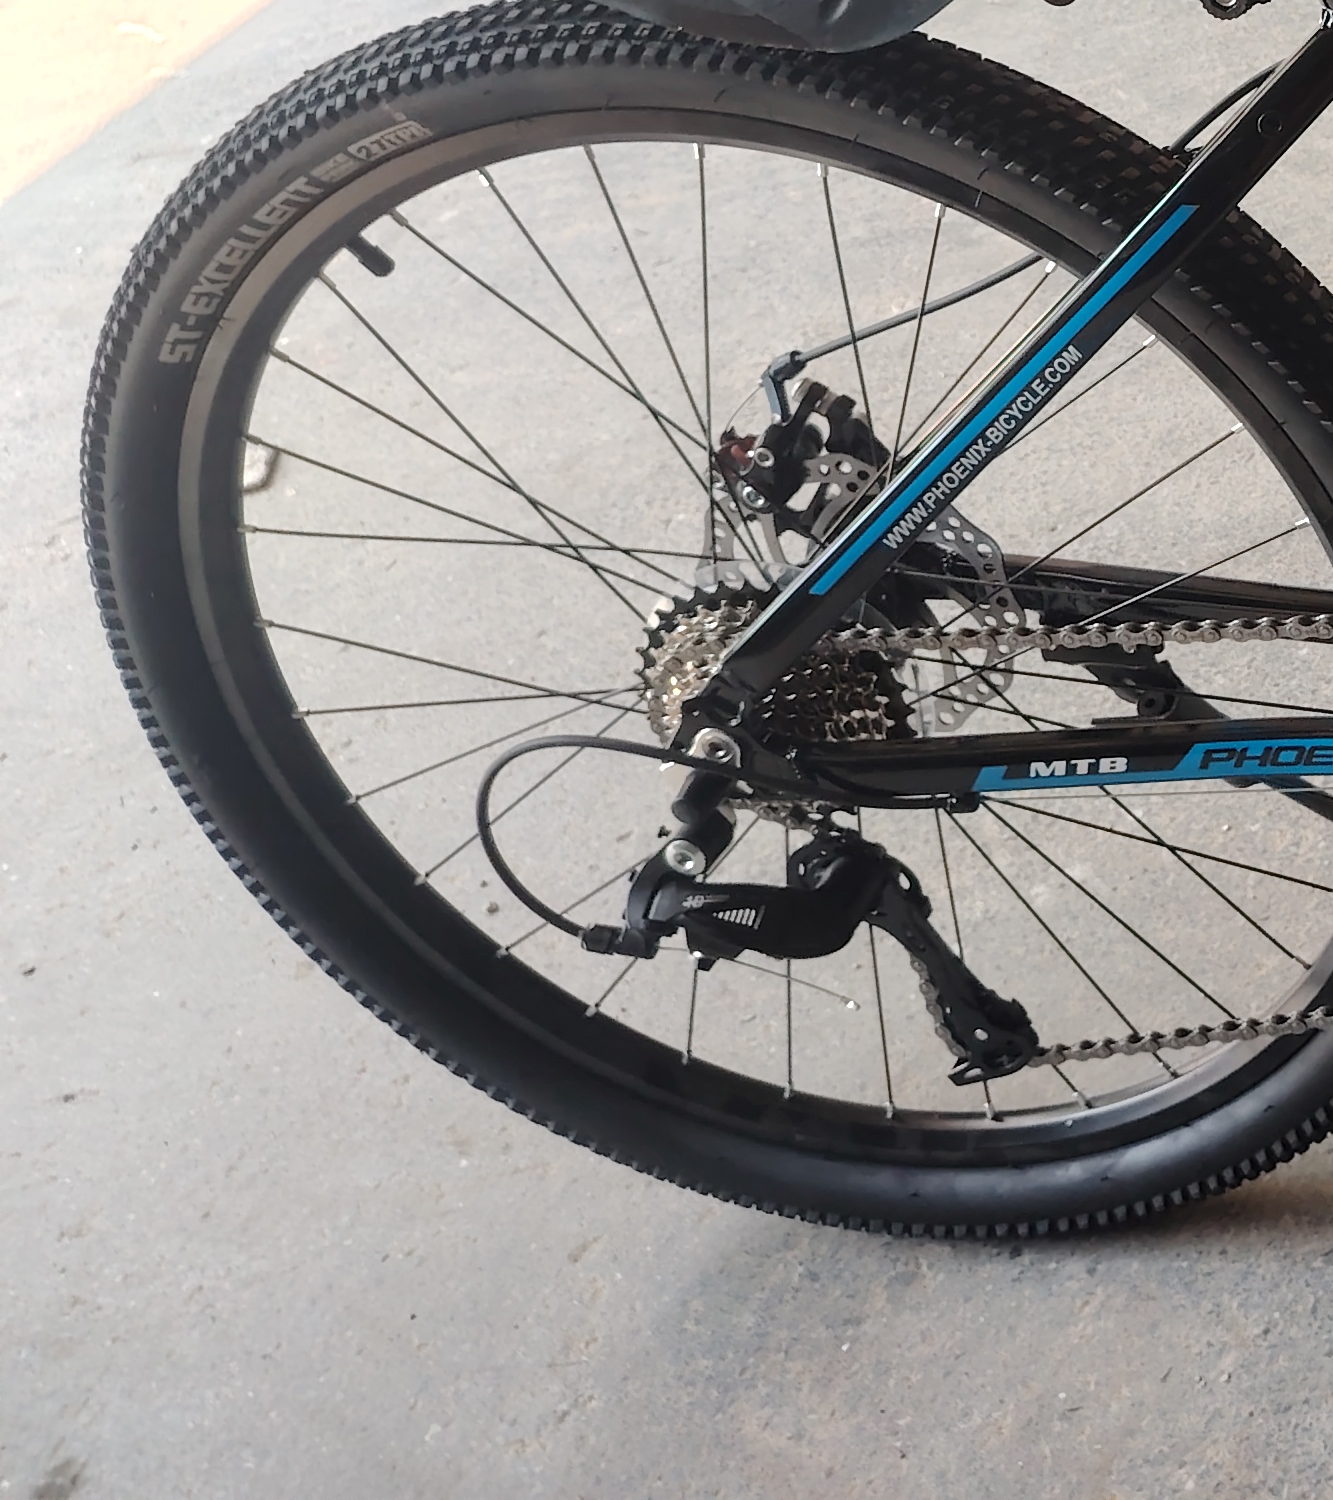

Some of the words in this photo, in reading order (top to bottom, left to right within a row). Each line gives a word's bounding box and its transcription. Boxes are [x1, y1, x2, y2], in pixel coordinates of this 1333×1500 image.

[158, 175, 326, 365] ST-EXCELLENT
[882, 345, 1084, 550] WWW.PHOENIX-BICYCLE.COM
[1029, 756, 1128, 779] MTB
